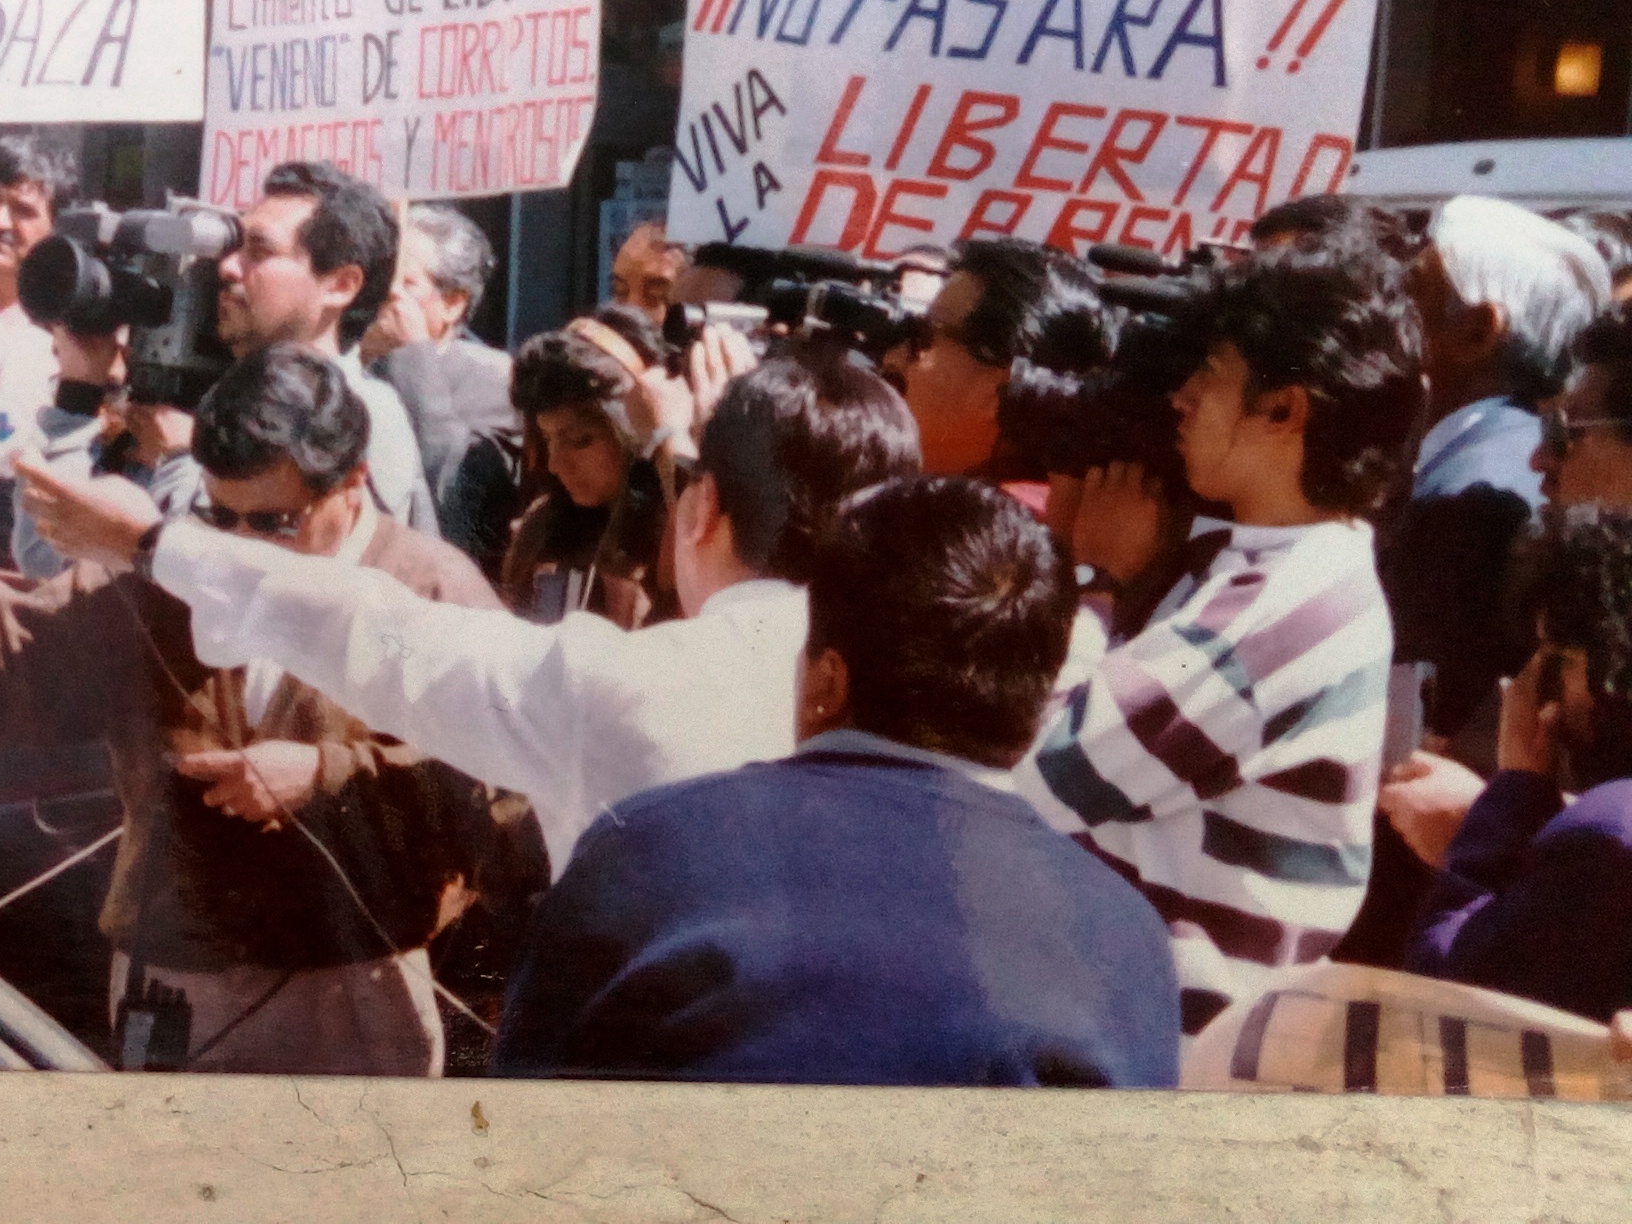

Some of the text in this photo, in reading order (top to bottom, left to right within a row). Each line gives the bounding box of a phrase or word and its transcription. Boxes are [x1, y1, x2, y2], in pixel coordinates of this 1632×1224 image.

[362, 29, 402, 107] DE
[404, 115, 421, 190] Y
[674, 68, 788, 194] VIVA
[812, 74, 1356, 215] LIBERTAD
[715, 160, 783, 244] LA
[786, 168, 950, 262] DE
